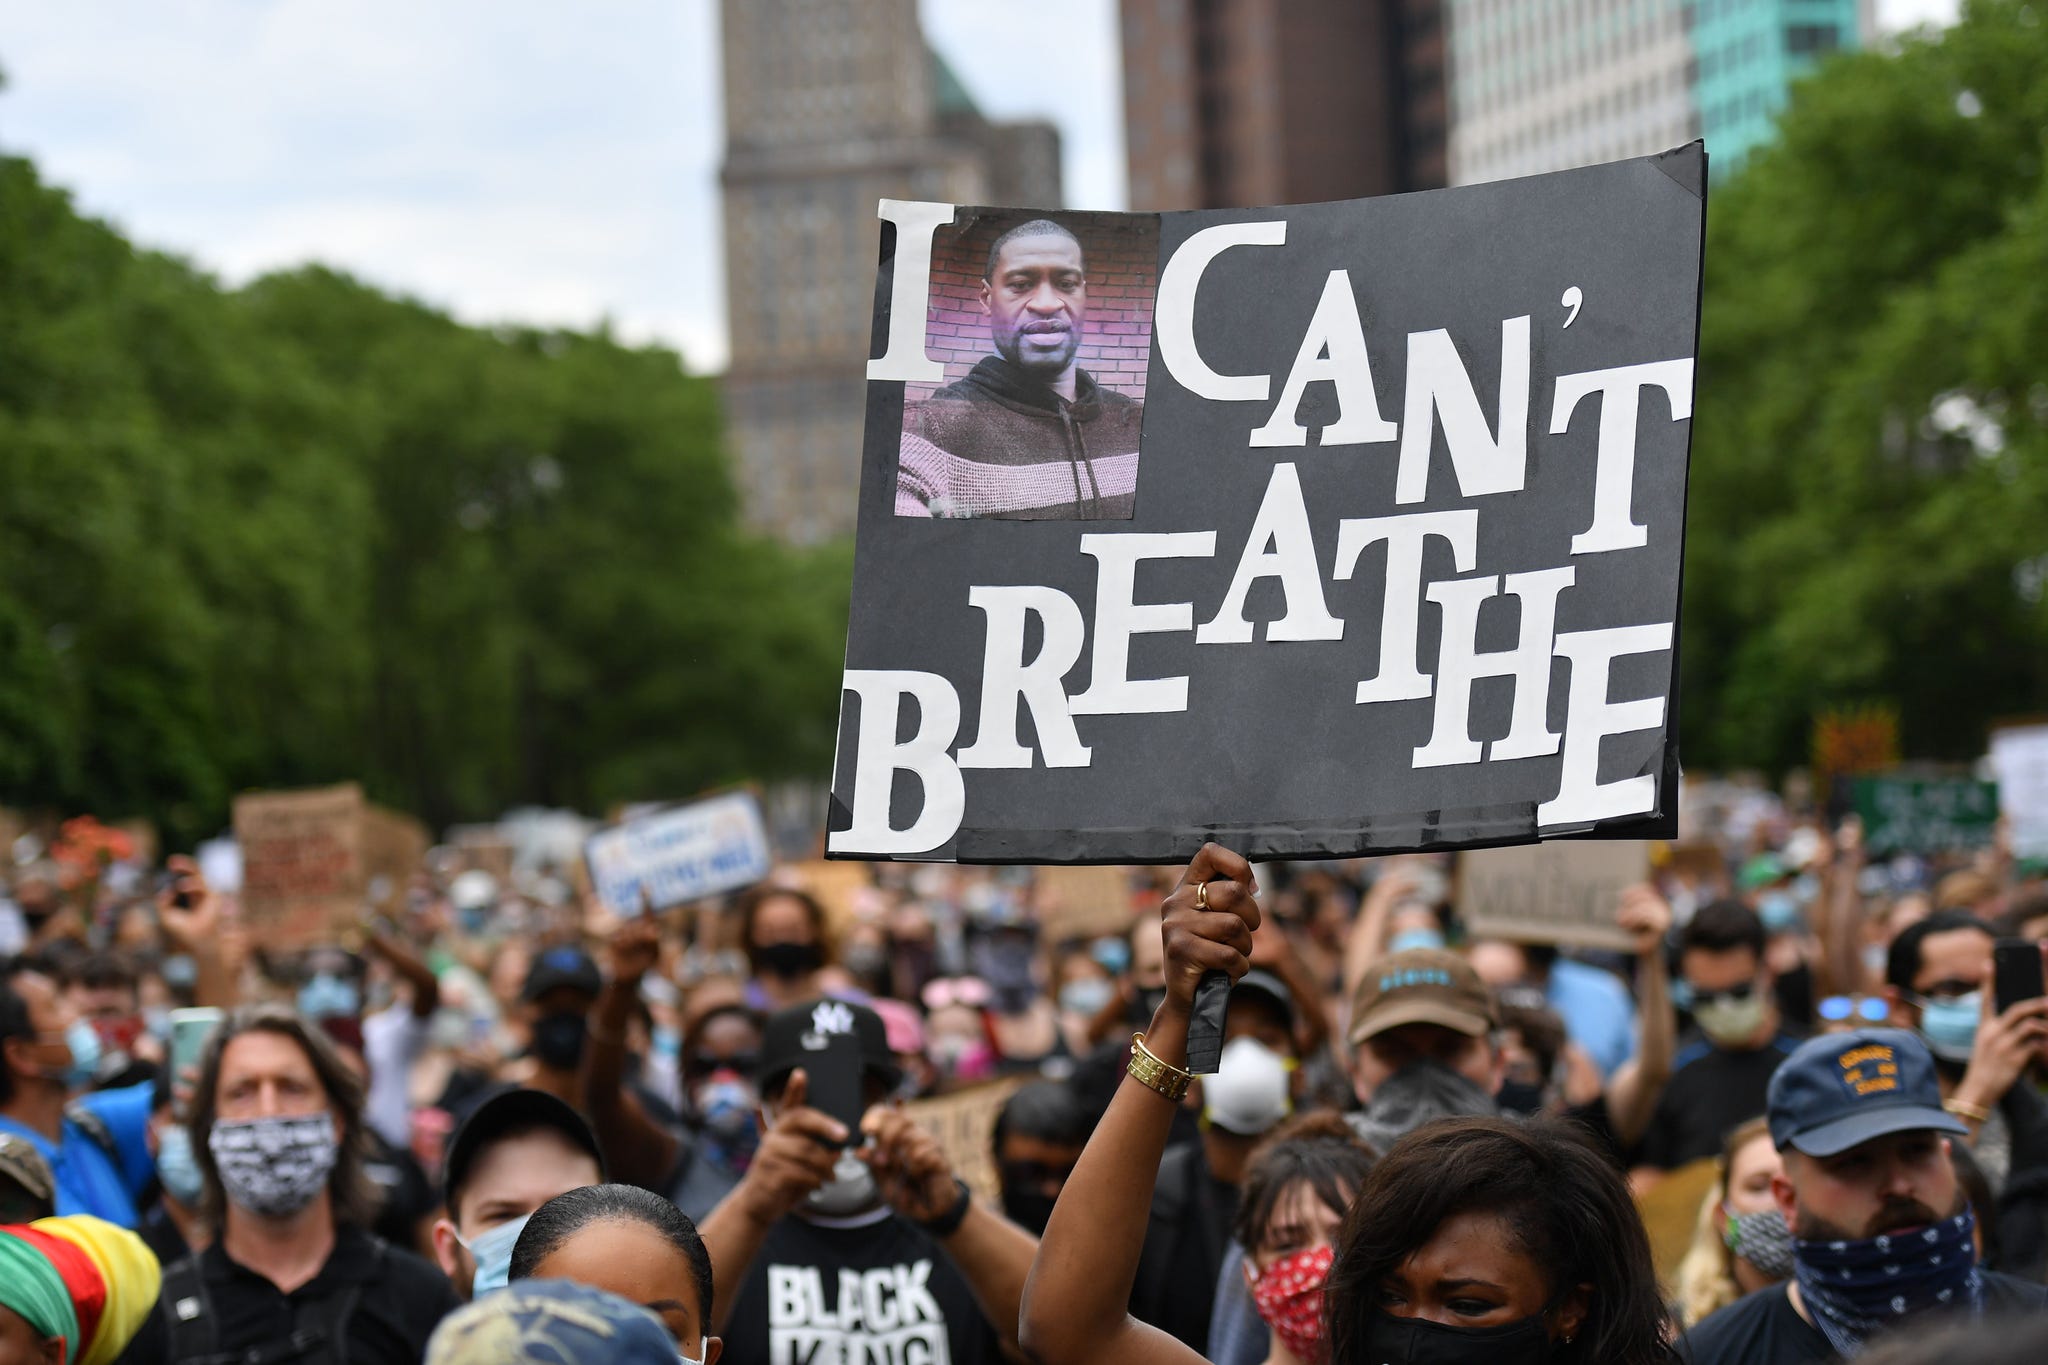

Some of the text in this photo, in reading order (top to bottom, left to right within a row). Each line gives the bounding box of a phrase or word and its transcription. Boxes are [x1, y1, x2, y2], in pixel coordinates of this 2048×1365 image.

[867, 198, 1696, 555] I CAN'T
[829, 461, 1675, 854] BREATHE
[767, 1258, 945, 1335] BLACK
